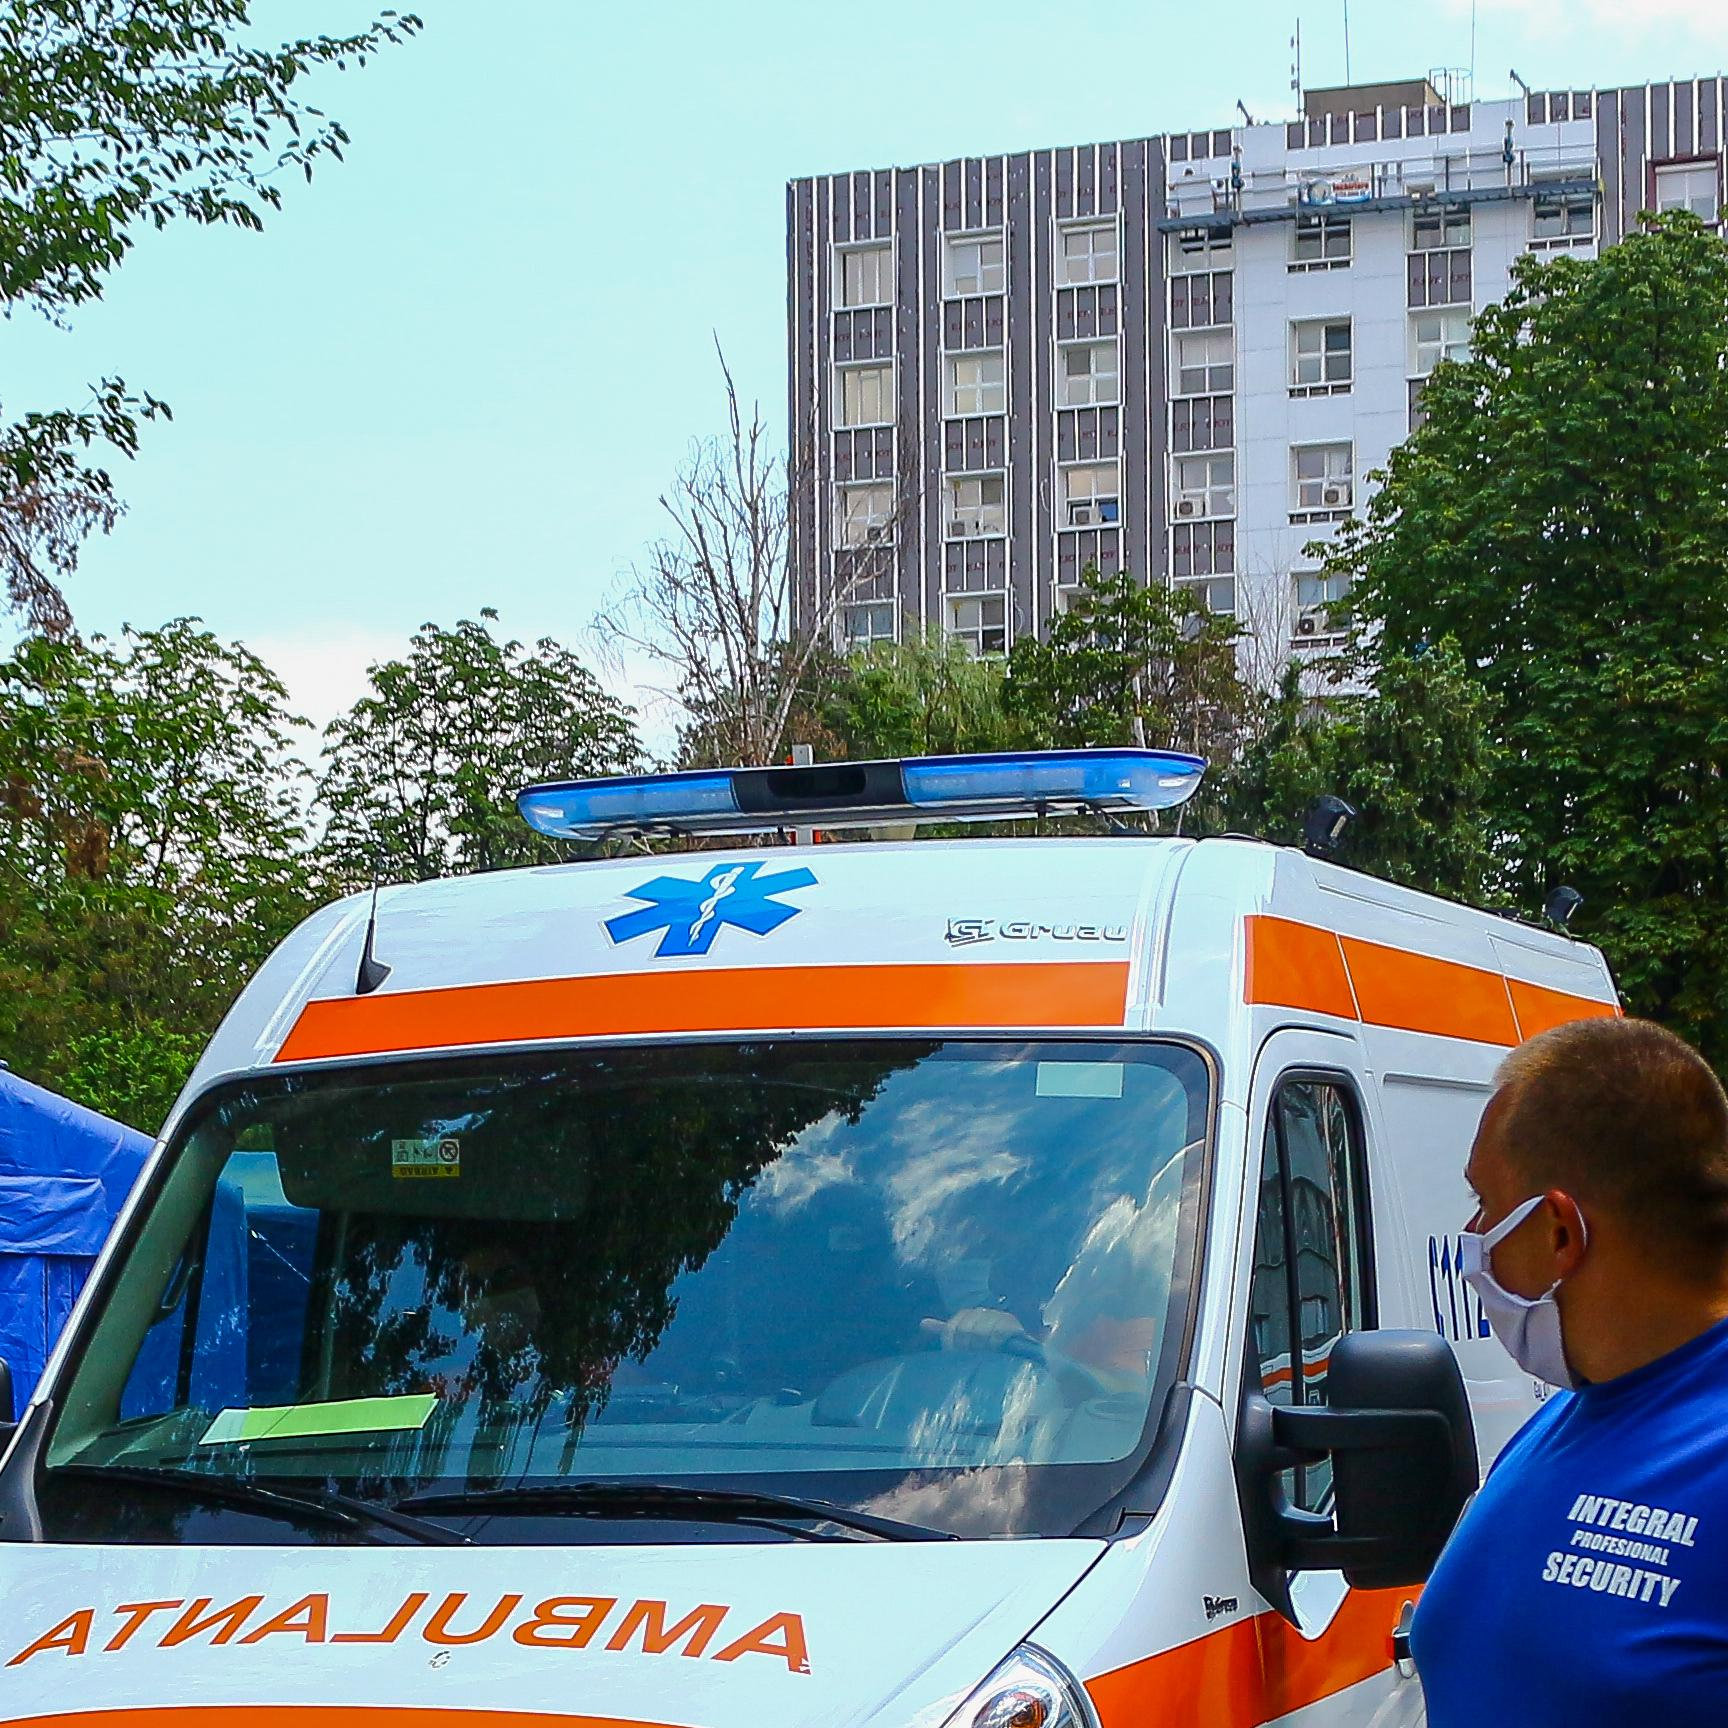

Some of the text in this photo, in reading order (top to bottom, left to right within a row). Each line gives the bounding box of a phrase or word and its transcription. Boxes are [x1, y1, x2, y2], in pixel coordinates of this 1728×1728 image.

[999, 922, 1128, 941] Gruau
[1567, 1494, 1699, 1547] INTEGRAL
[1570, 1529, 1670, 1566] PROFESIONAL
[1542, 1552, 1681, 1608] SECURITY
